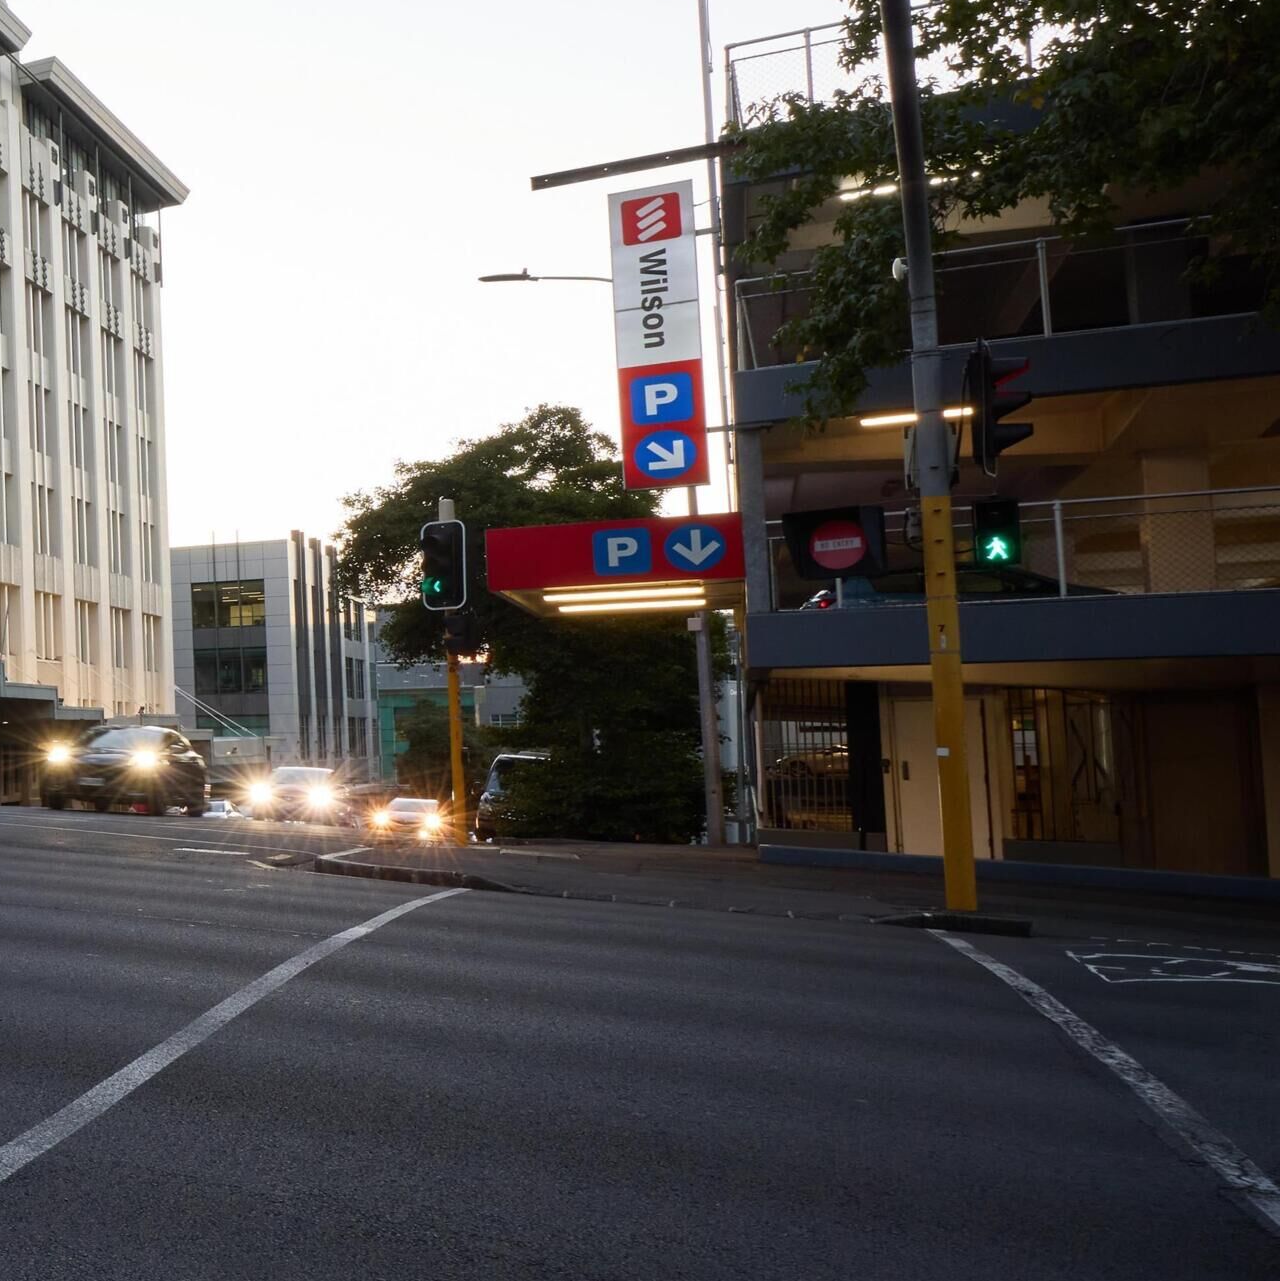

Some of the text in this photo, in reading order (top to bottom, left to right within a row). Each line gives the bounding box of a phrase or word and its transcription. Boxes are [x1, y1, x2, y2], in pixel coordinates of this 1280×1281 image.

[639, 248, 669, 349] Wilson
[644, 383, 678, 416] P
[607, 537, 638, 567] P
[937, 624, 945, 632] 7
